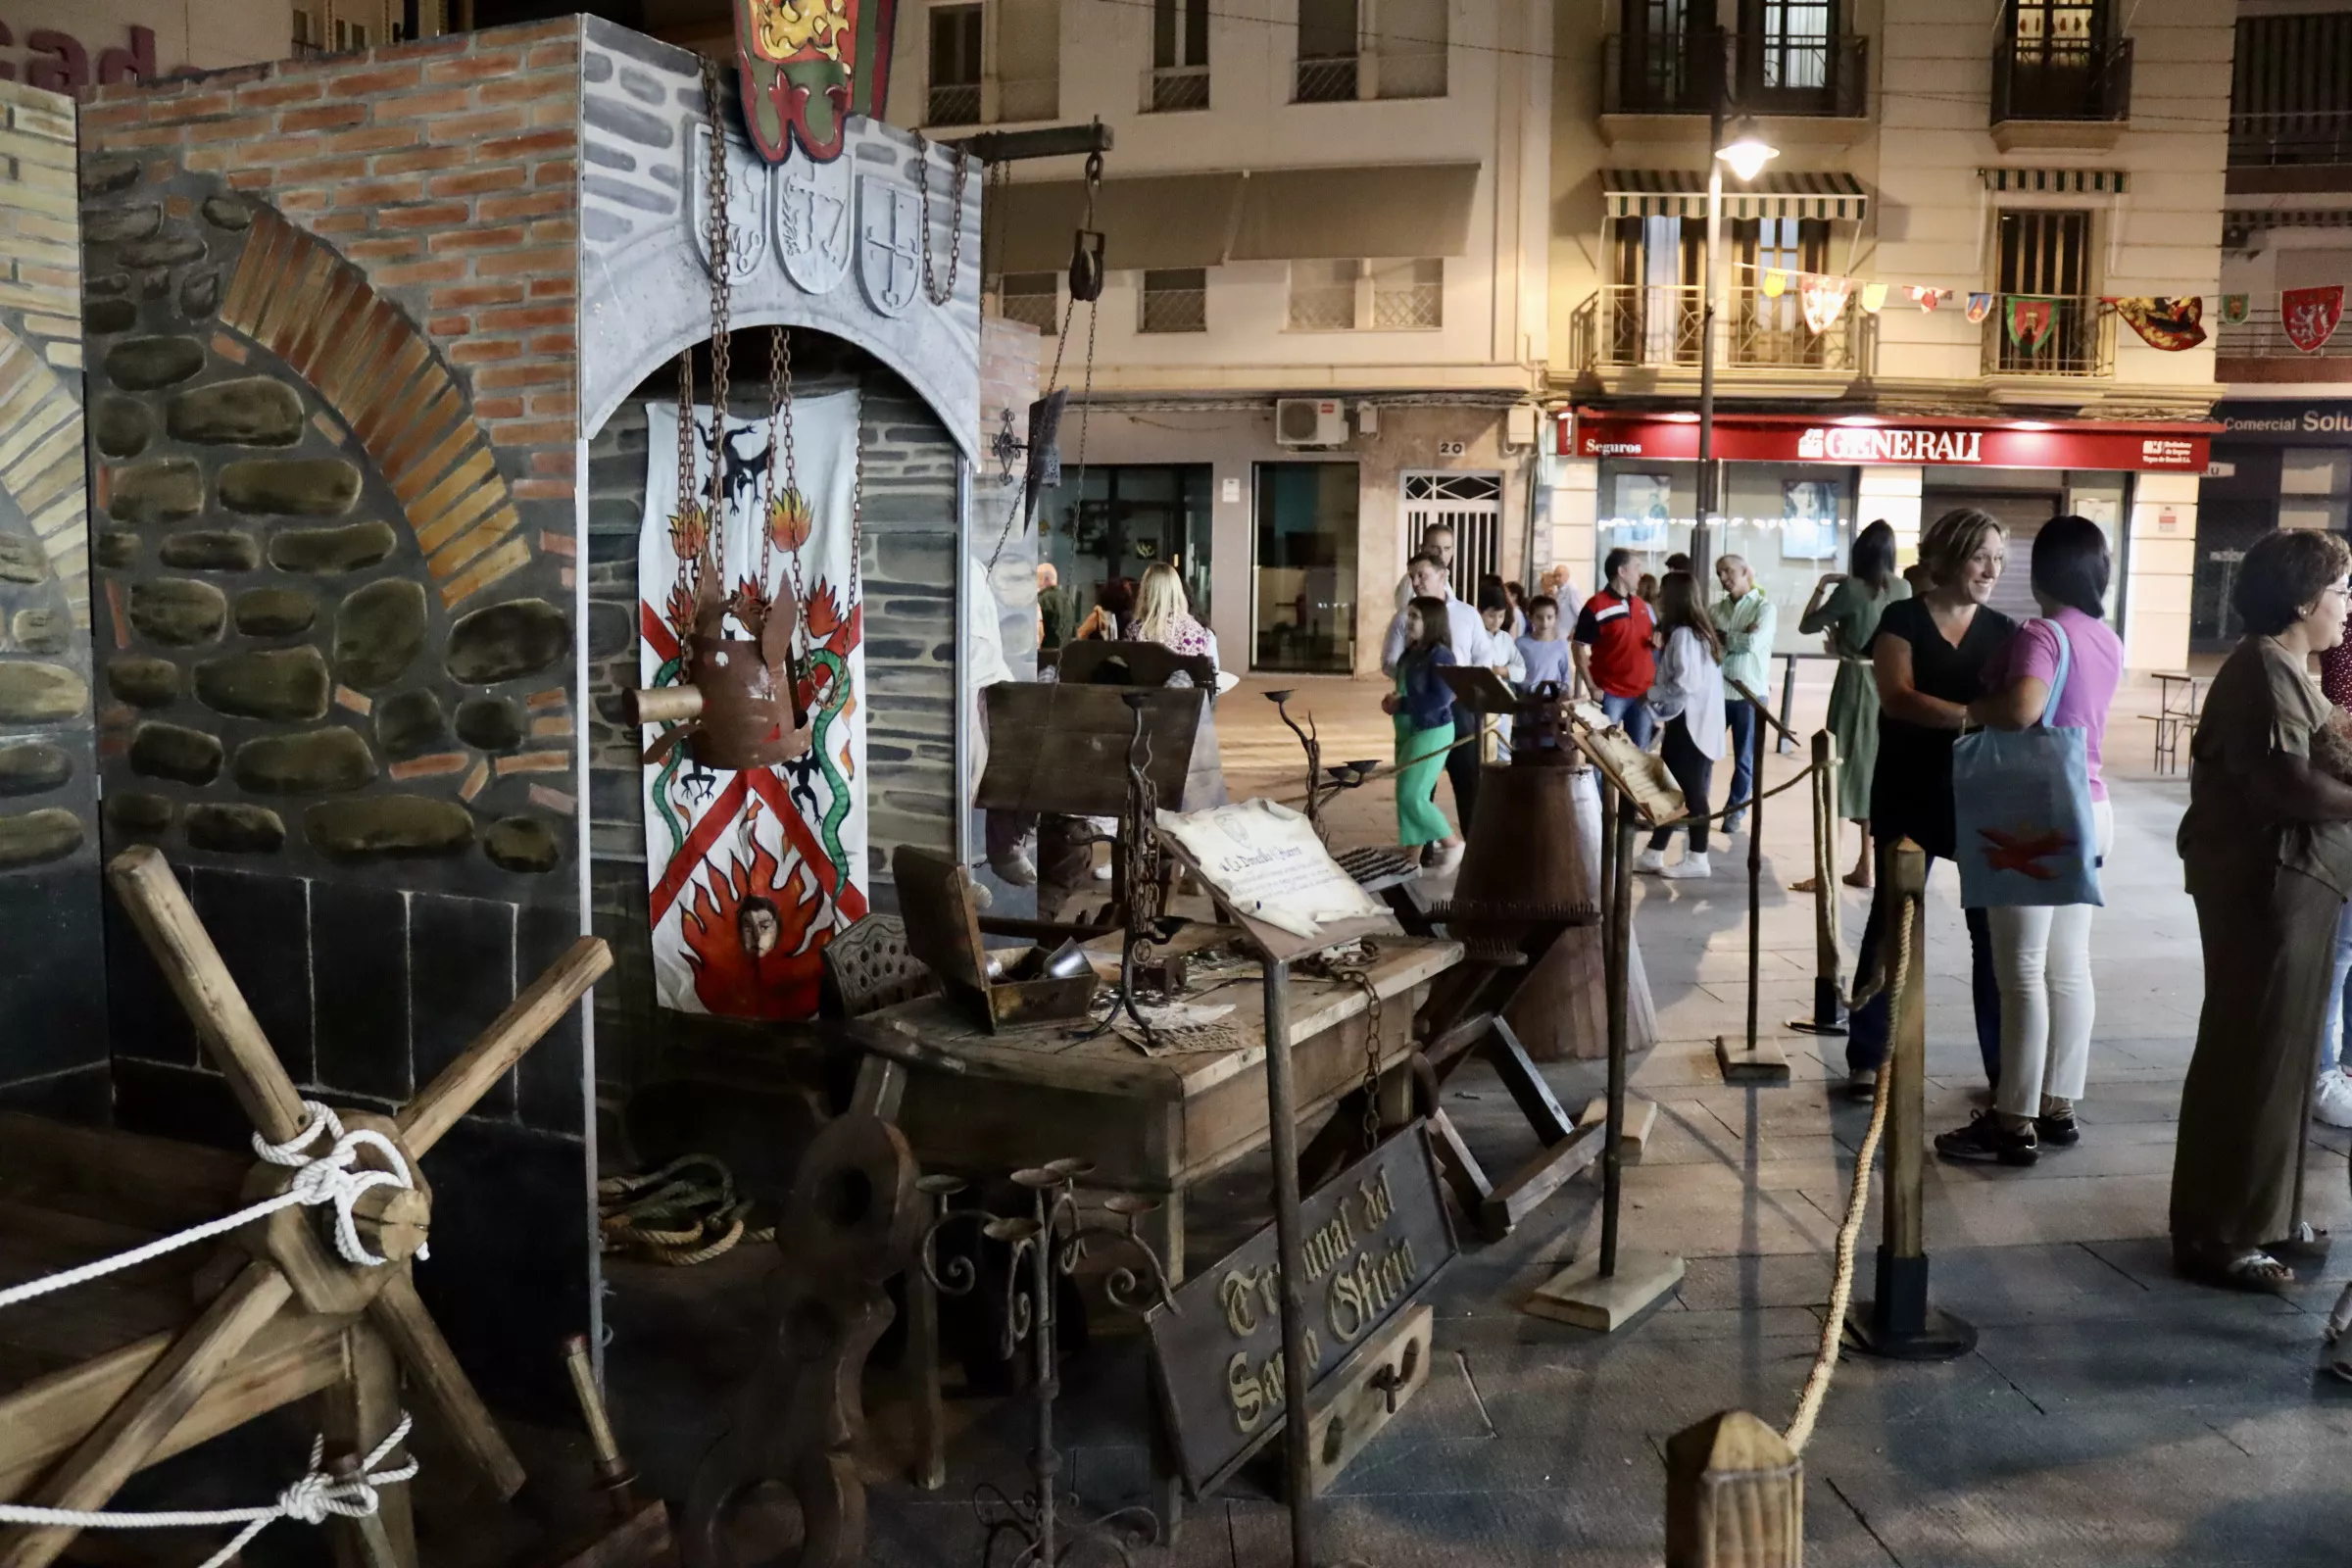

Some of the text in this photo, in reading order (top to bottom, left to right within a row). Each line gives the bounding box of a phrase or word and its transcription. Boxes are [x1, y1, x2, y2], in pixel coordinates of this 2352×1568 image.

[2224, 416, 2297, 431] Comercial
[1440, 442, 1463, 454] 20
[1586, 438, 1642, 455] Seguros
[1824, 428, 1984, 462] GENERALI
[1219, 1163, 1396, 1337] Trunal del
[1329, 1237, 1416, 1344] Oficio
